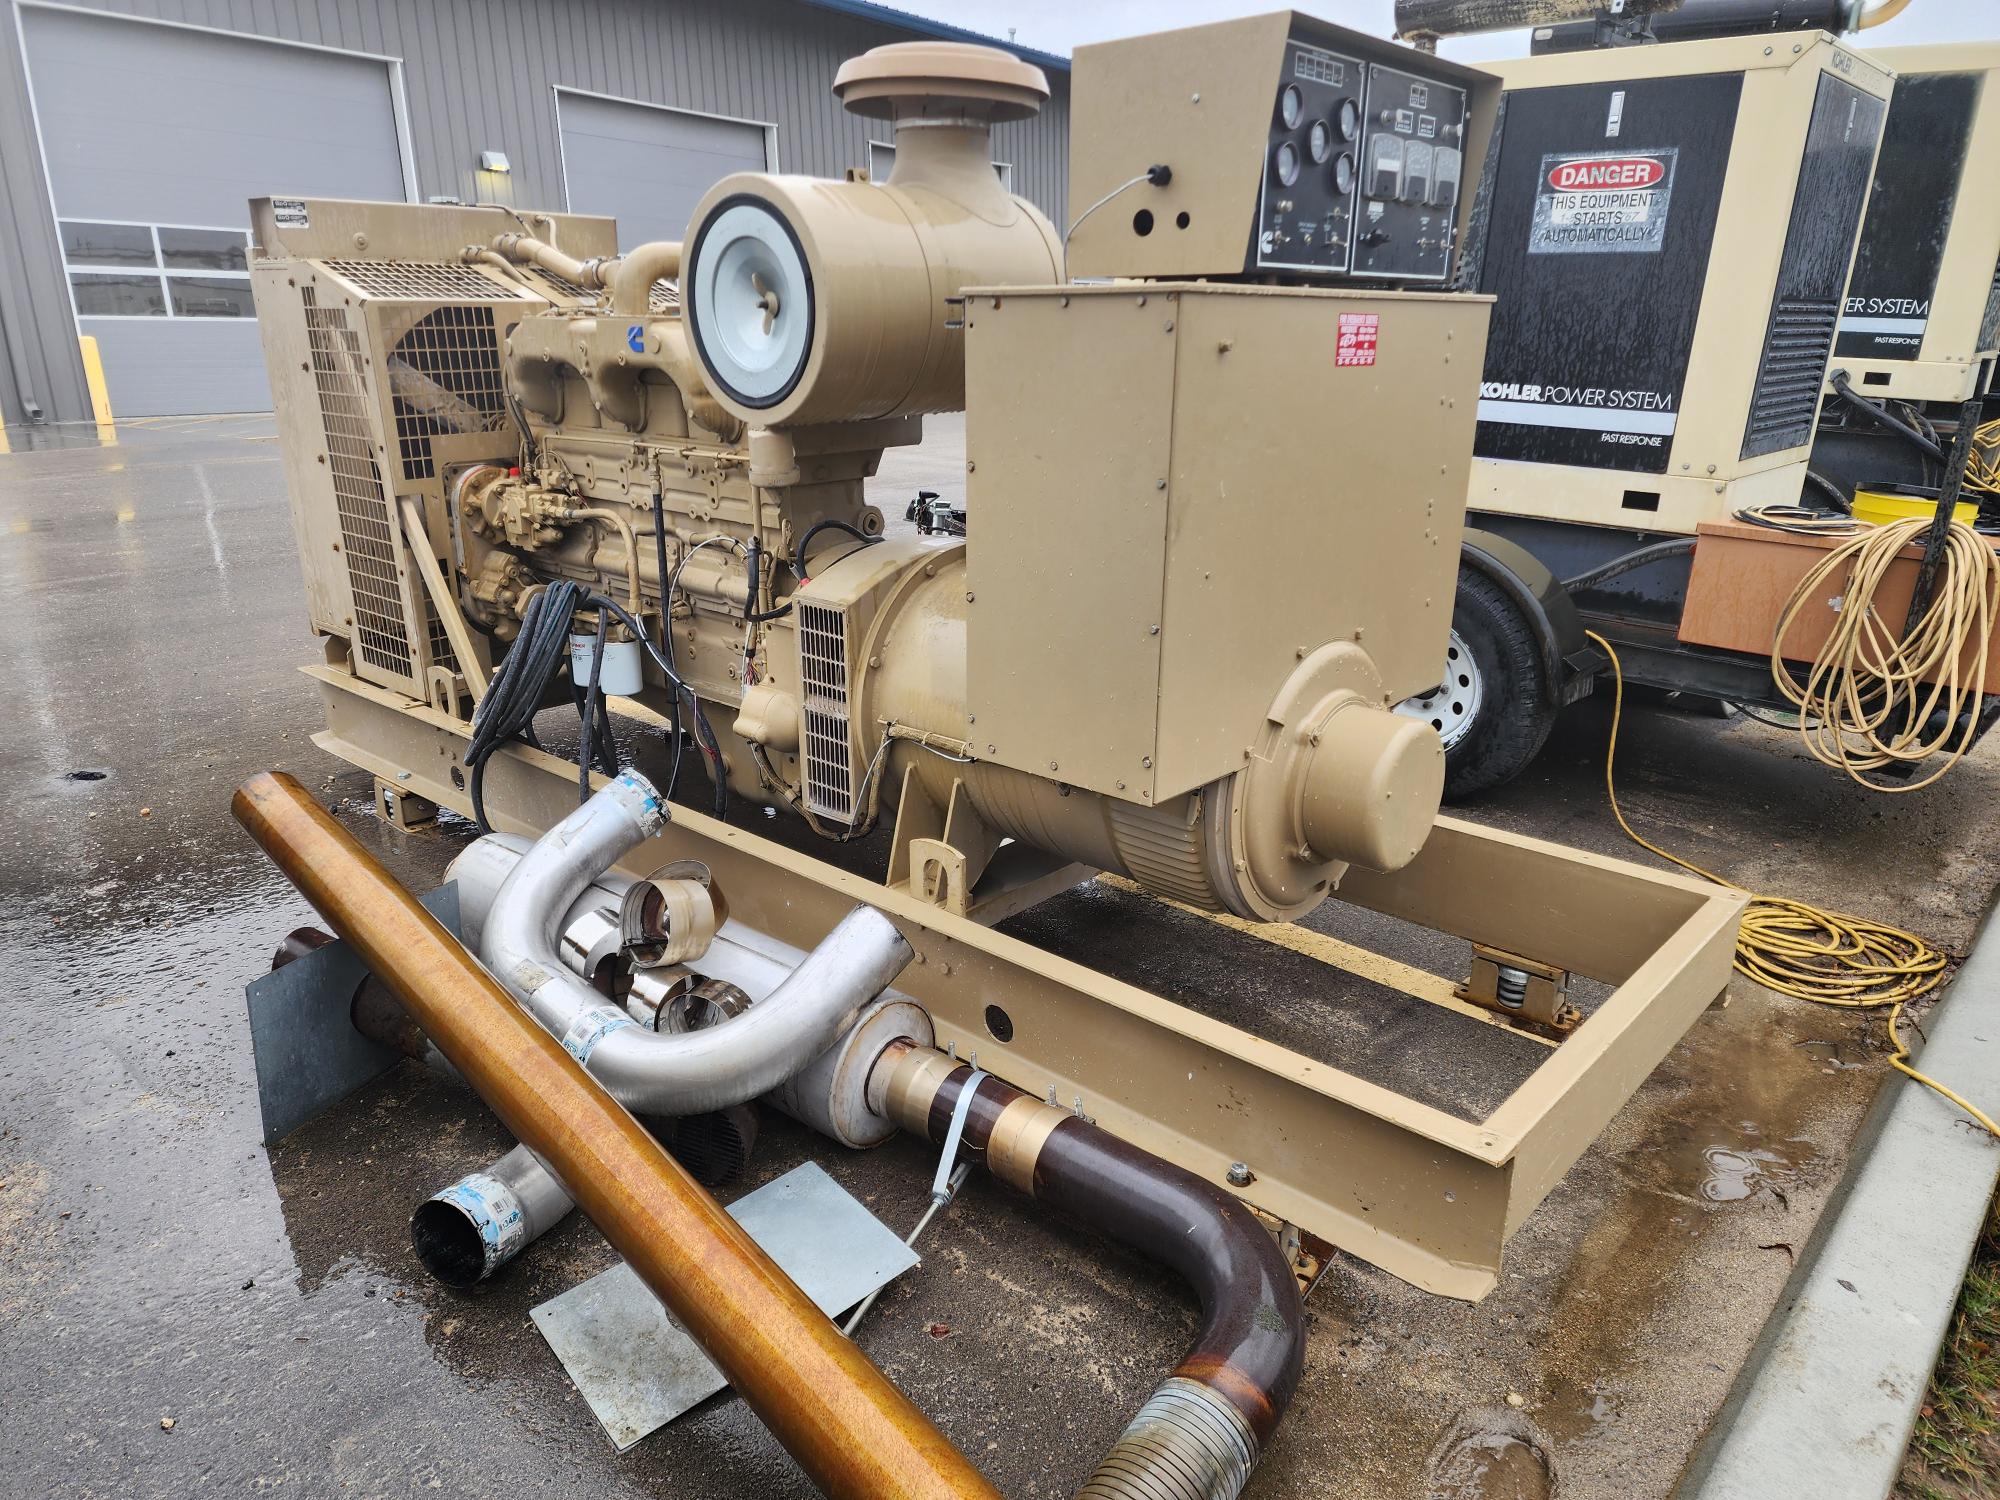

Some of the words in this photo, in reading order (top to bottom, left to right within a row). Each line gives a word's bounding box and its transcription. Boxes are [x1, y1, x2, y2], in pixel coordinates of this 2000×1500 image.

[1560, 164, 1651, 186] DANGER
[1550, 194, 1576, 209] THIS
[1580, 192, 1656, 208] EQUIPMENT
[1573, 211, 1623, 226] STARTS
[1543, 227, 1649, 243] AUTOMATICALLY
[1867, 298, 1928, 315] SYSTEM
[1874, 336, 1889, 344] FAST
[1544, 386, 1605, 406] POWER
[1608, 390, 1672, 410] SYSTEM
[1601, 432, 1620, 443] FAST
[1619, 434, 1662, 447] RESPONSE
